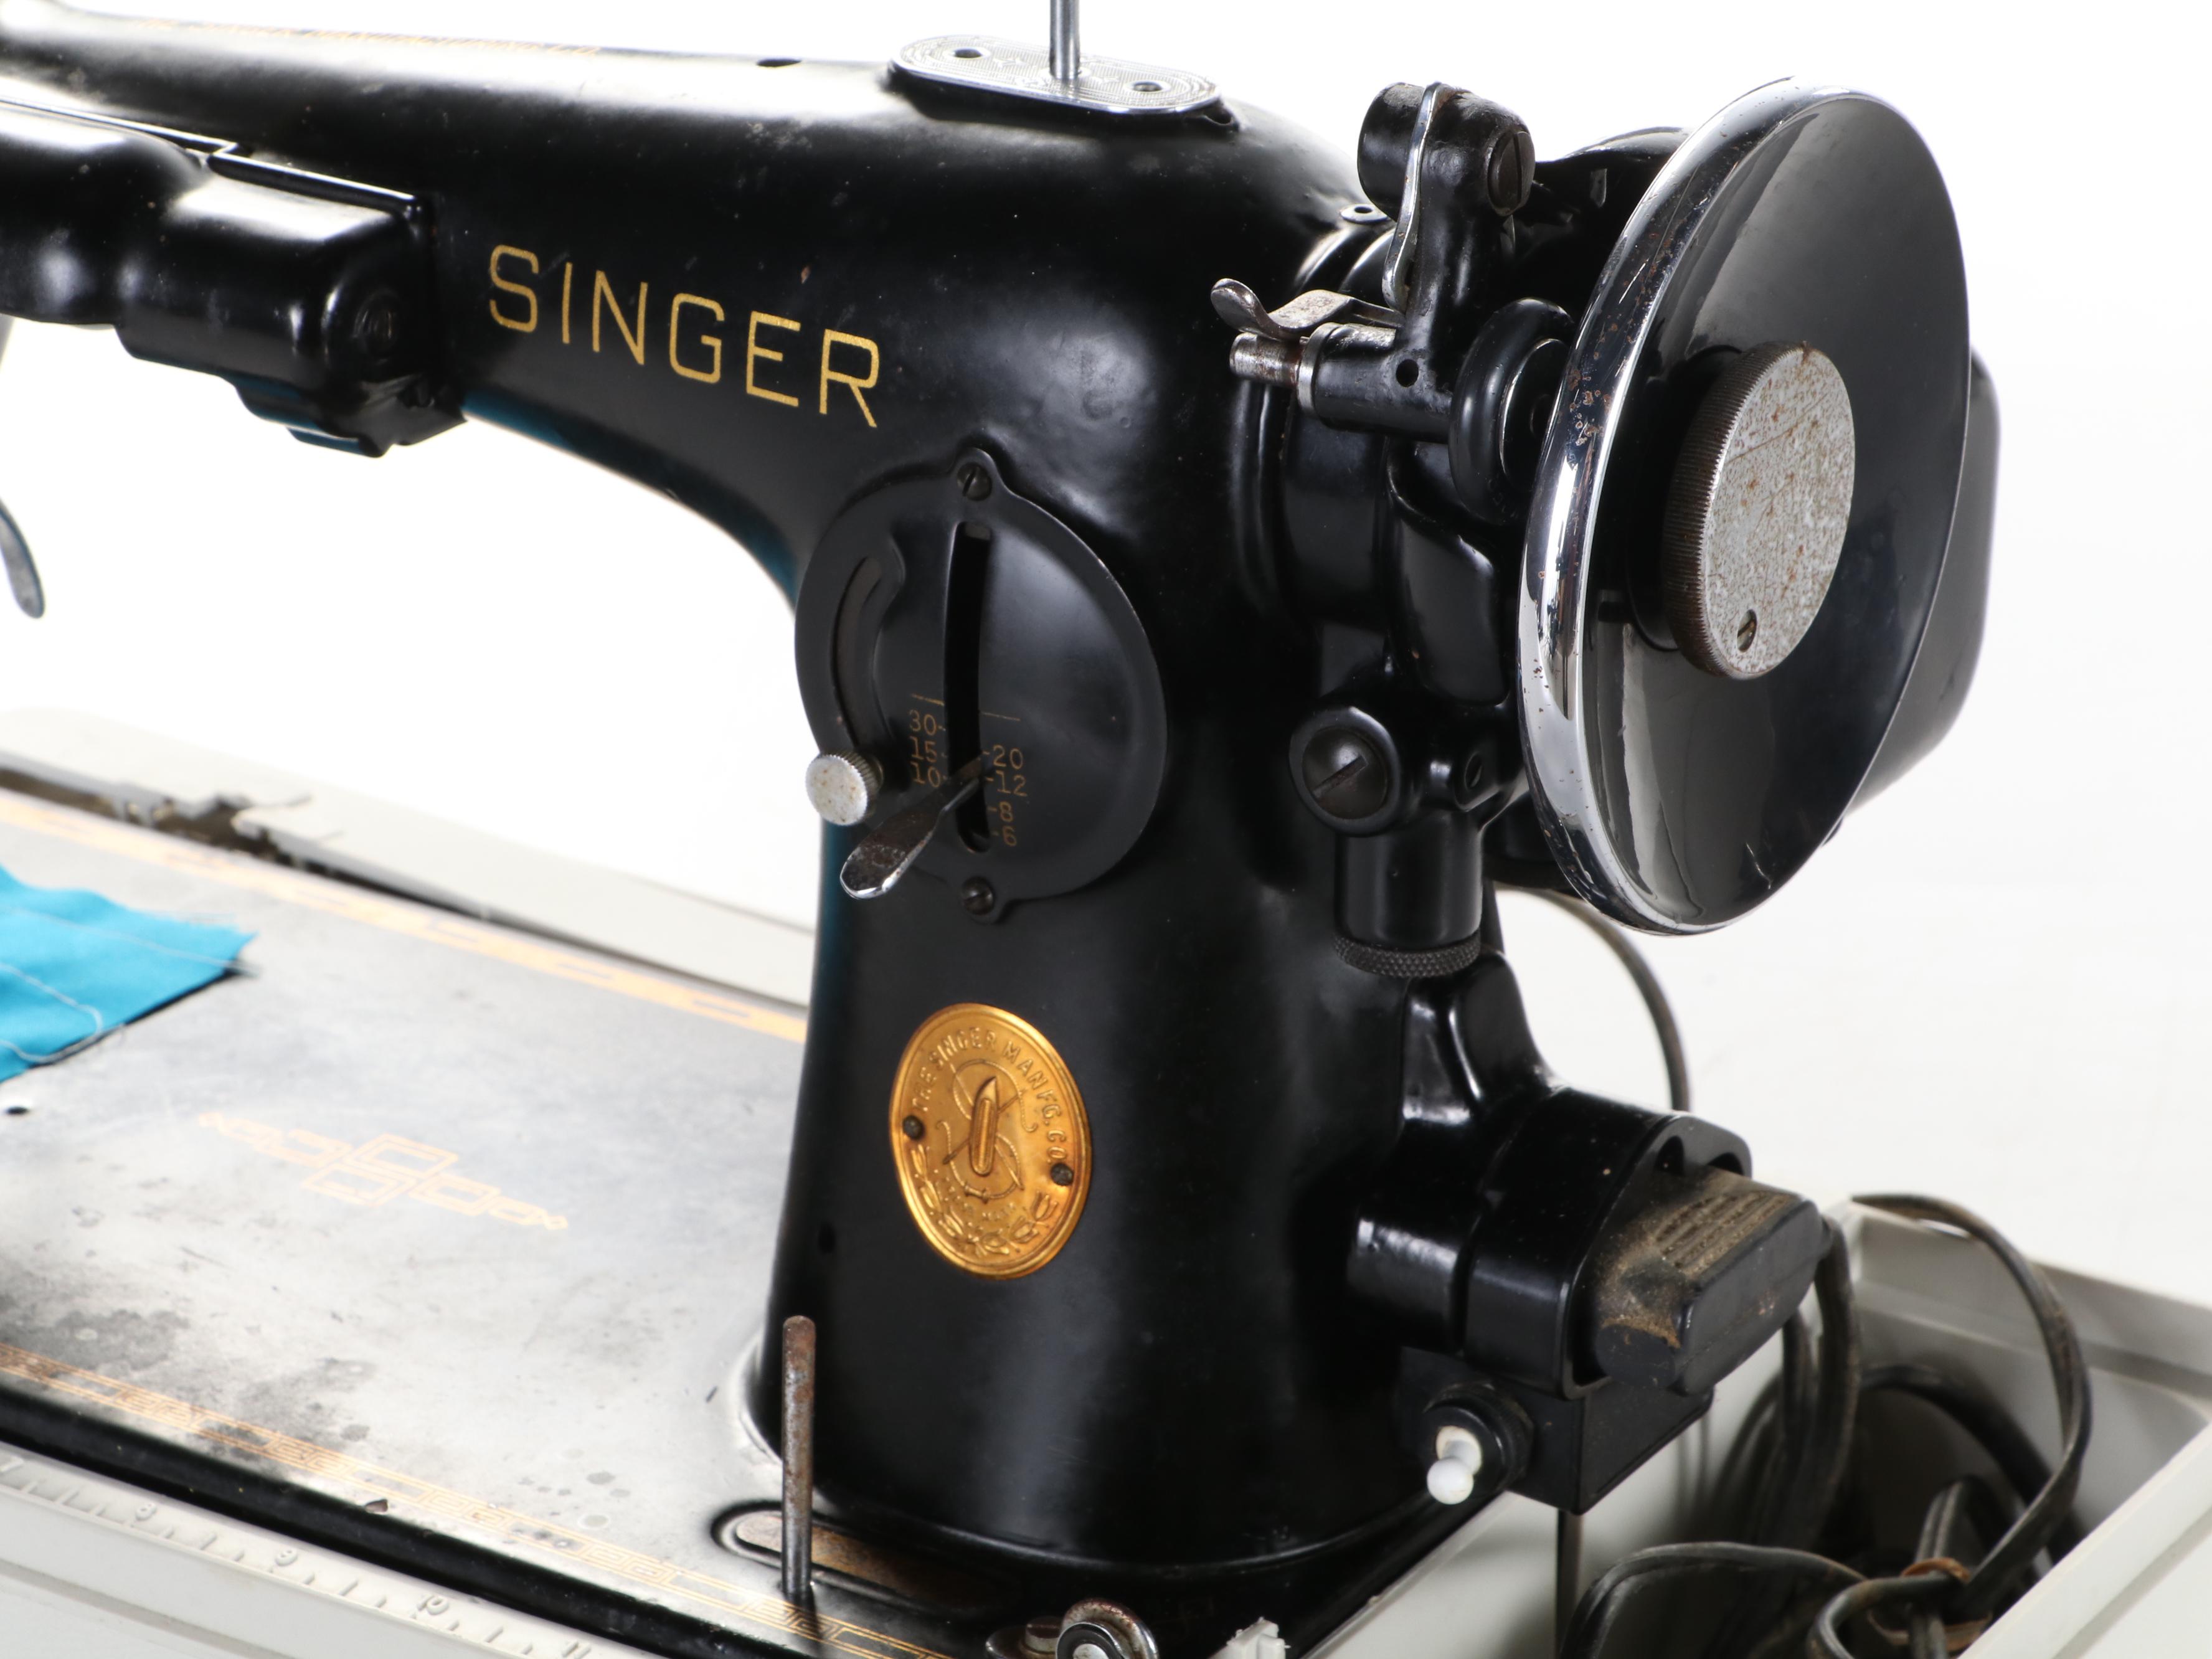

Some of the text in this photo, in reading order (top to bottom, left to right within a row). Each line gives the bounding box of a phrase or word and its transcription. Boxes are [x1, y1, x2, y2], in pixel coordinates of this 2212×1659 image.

[489, 244, 881, 428] SINGER
[909, 709, 937, 736] 30
[909, 735, 937, 763] 15
[993, 744, 1024, 770] 20
[910, 761, 941, 788] 10
[995, 770, 1028, 796] 12
[999, 801, 1014, 822] 8
[1001, 825, 1018, 847] 6
[929, 1026, 998, 1071] SINGER
